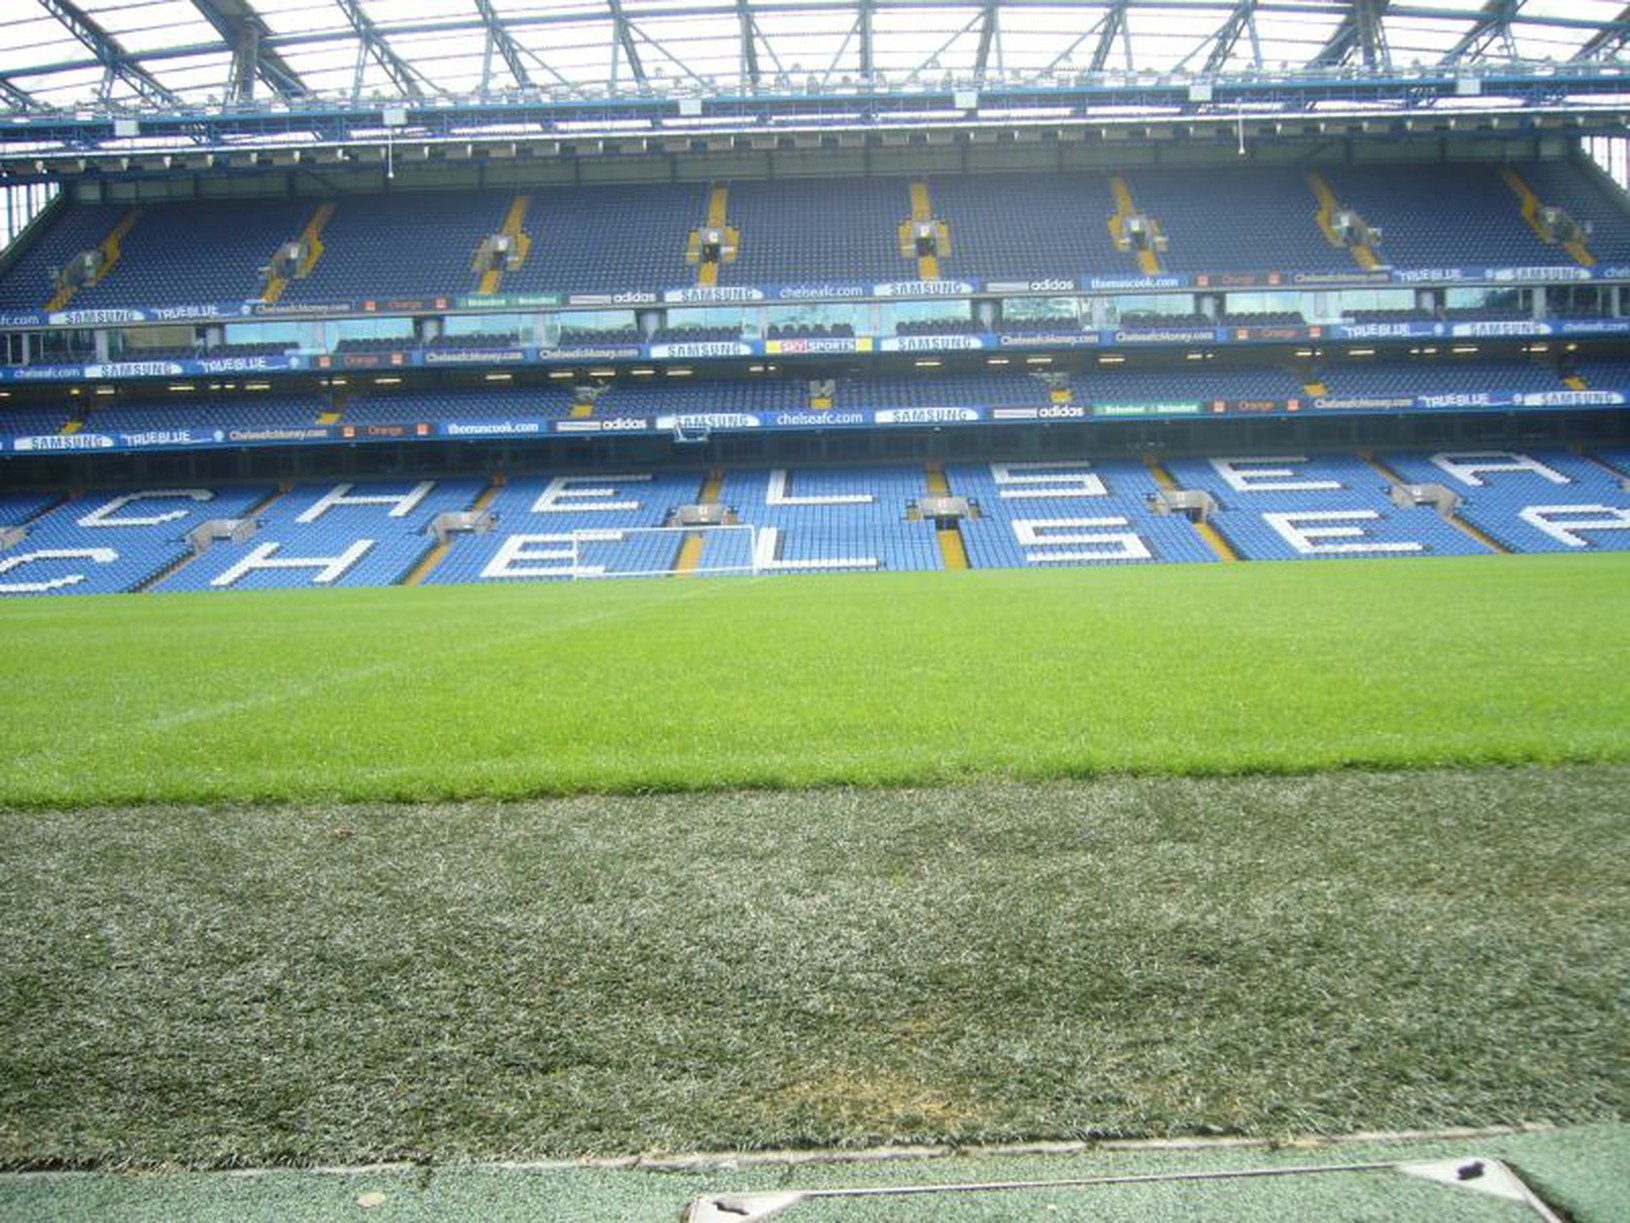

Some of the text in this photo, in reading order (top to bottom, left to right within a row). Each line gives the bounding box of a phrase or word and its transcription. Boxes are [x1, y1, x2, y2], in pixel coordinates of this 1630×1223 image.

[780, 284, 863, 298] chelseafc.com
[891, 282, 963, 295] SAMSUNG
[1031, 279, 1074, 291] adidas
[613, 292, 656, 303] adidas
[682, 288, 753, 301] SAMSUNG
[899, 336, 971, 349] SAMSUNG
[668, 345, 741, 357] SAMSUNG
[101, 364, 171, 377] SAMSUNG
[893, 408, 967, 421] SAMSUNG
[1039, 405, 1084, 417] adidas
[603, 418, 648, 430] adidas
[777, 411, 863, 425] chelseafc.com
[448, 421, 539, 435] thomascook.com
[31, 436, 102, 449] SAMSUNG
